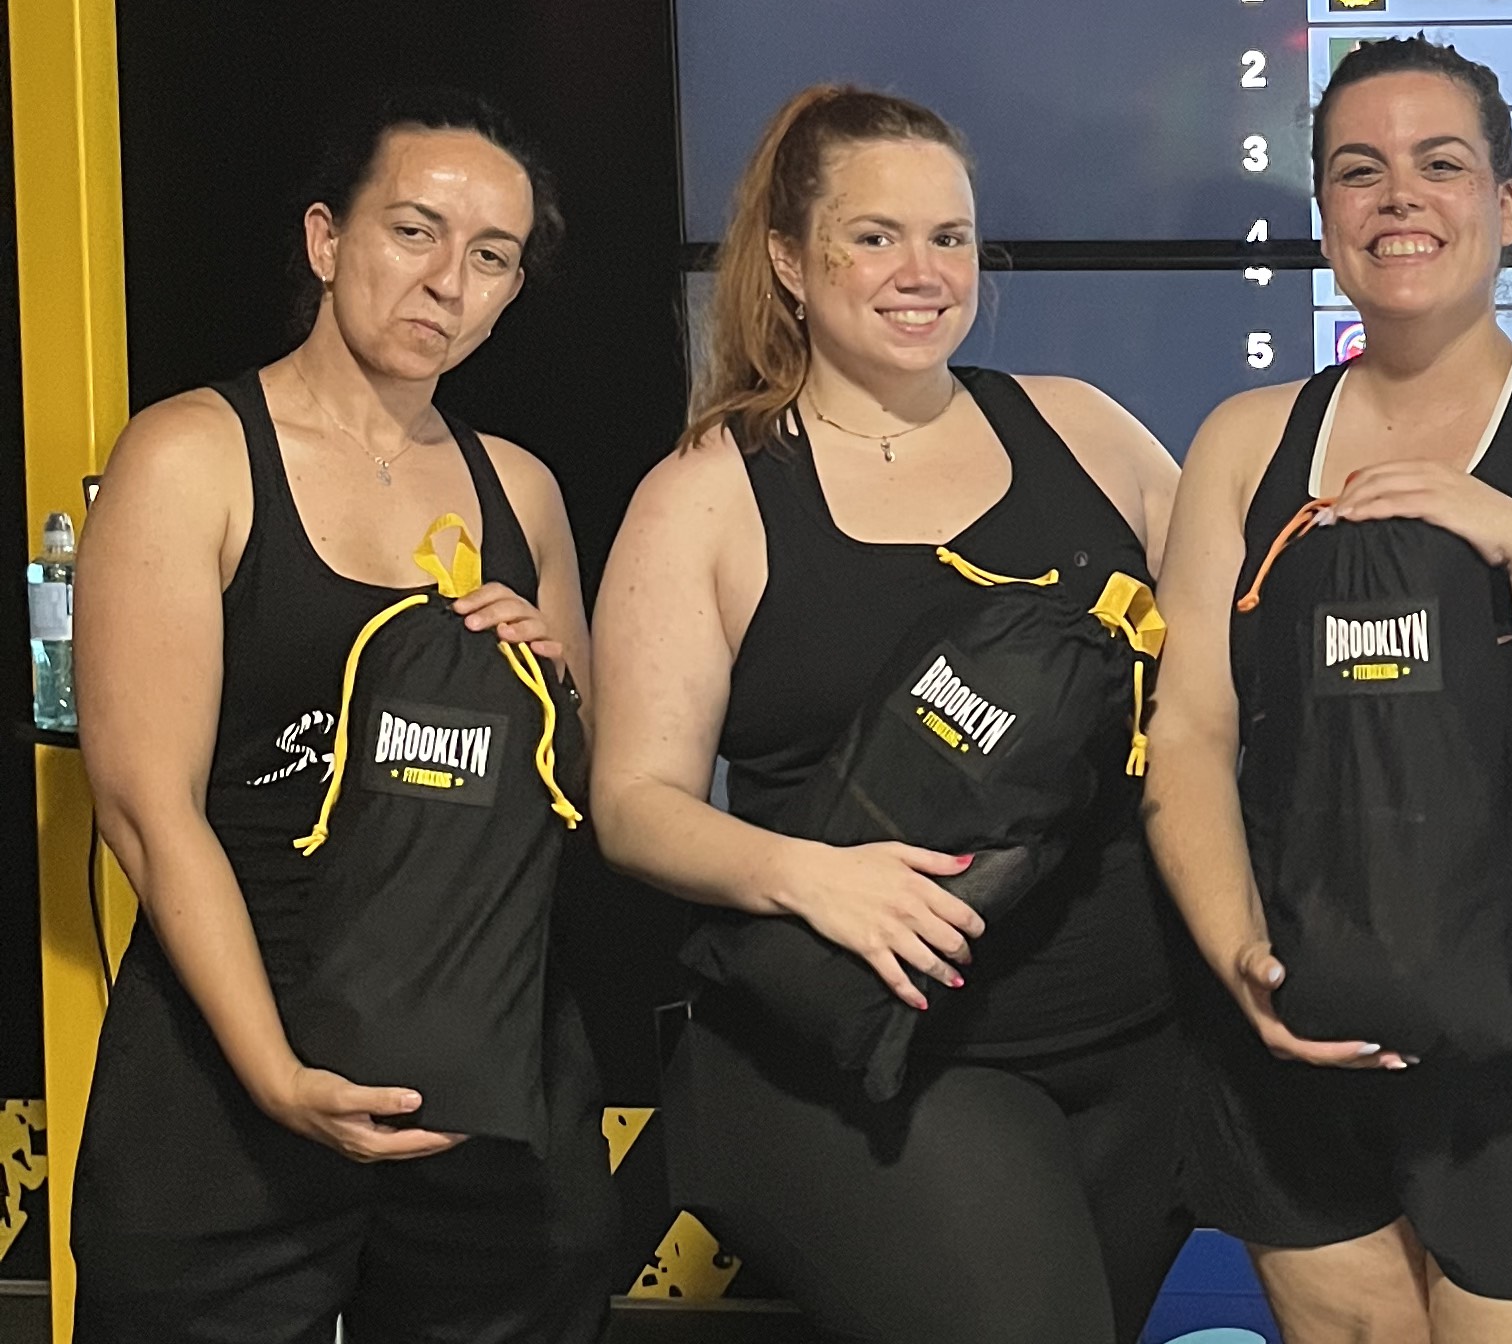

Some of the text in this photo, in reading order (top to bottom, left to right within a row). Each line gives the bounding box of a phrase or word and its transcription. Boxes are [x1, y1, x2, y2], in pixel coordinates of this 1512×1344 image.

[1240, 50, 1268, 88] 2
[1242, 135, 1269, 172] 3
[1247, 332, 1274, 369] 5
[1325, 609, 1429, 667] BROOKLYN
[910, 655, 1017, 755] BROOKLYN
[375, 711, 492, 777] BROOKLYN
